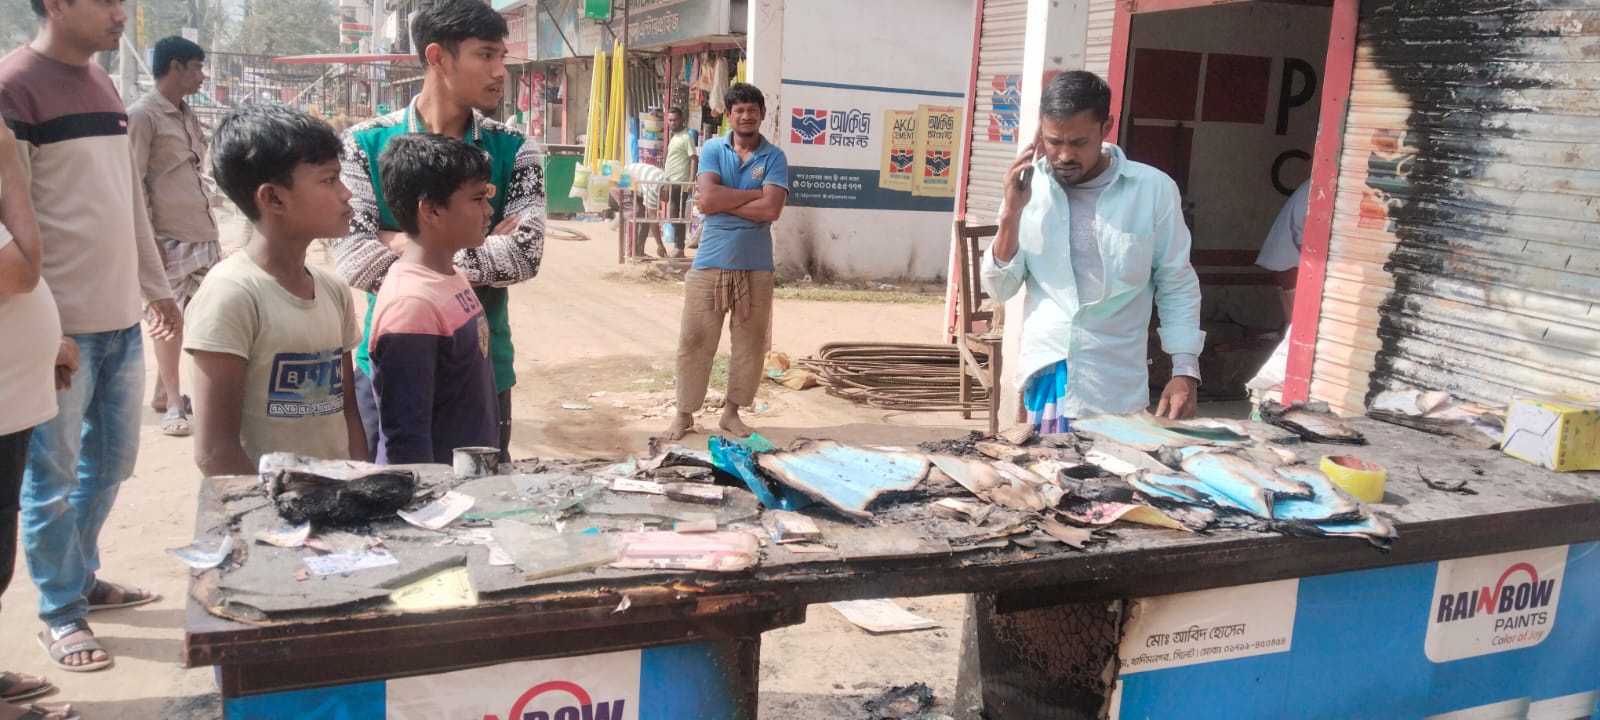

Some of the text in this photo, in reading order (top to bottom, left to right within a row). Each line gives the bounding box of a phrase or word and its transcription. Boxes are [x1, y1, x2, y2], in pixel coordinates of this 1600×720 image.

[830, 108, 871, 134] আকিজ
[829, 133, 869, 148] সিমেন্ট
[892, 132, 915, 140] CEMENT
[1436, 562, 1555, 623] RAINBOW
[1494, 611, 1548, 632] PAINTS
[1145, 623, 1246, 648] মোঃ আবিদ হোসেন
